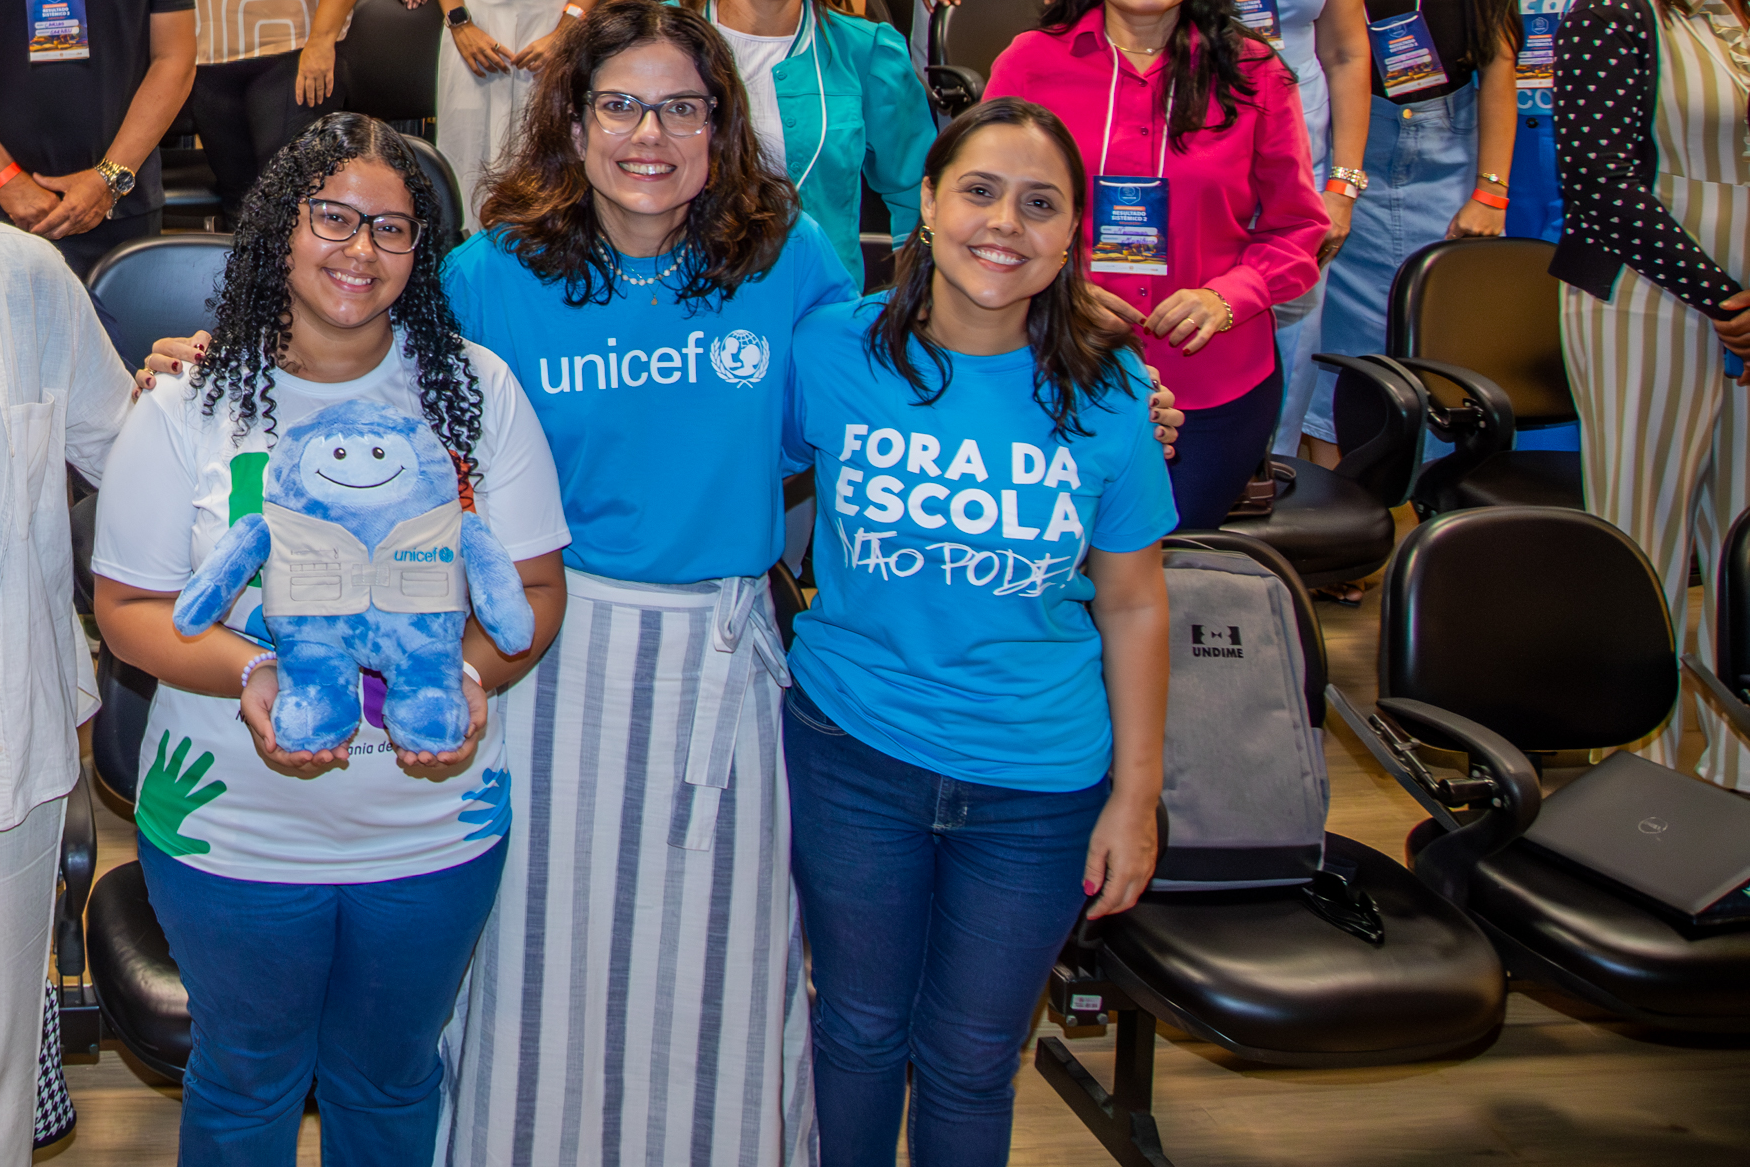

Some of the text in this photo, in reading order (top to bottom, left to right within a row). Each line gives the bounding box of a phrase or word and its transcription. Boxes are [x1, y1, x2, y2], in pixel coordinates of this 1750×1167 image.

[539, 330, 705, 394] unicef
[838, 423, 1082, 490] FORA DA
[835, 465, 1085, 542] ESCOLA
[394, 547, 438, 563] unicef
[834, 517, 925, 582] NÃO
[1191, 646, 1245, 659] UNDIME
[377, 740, 393, 752] de
